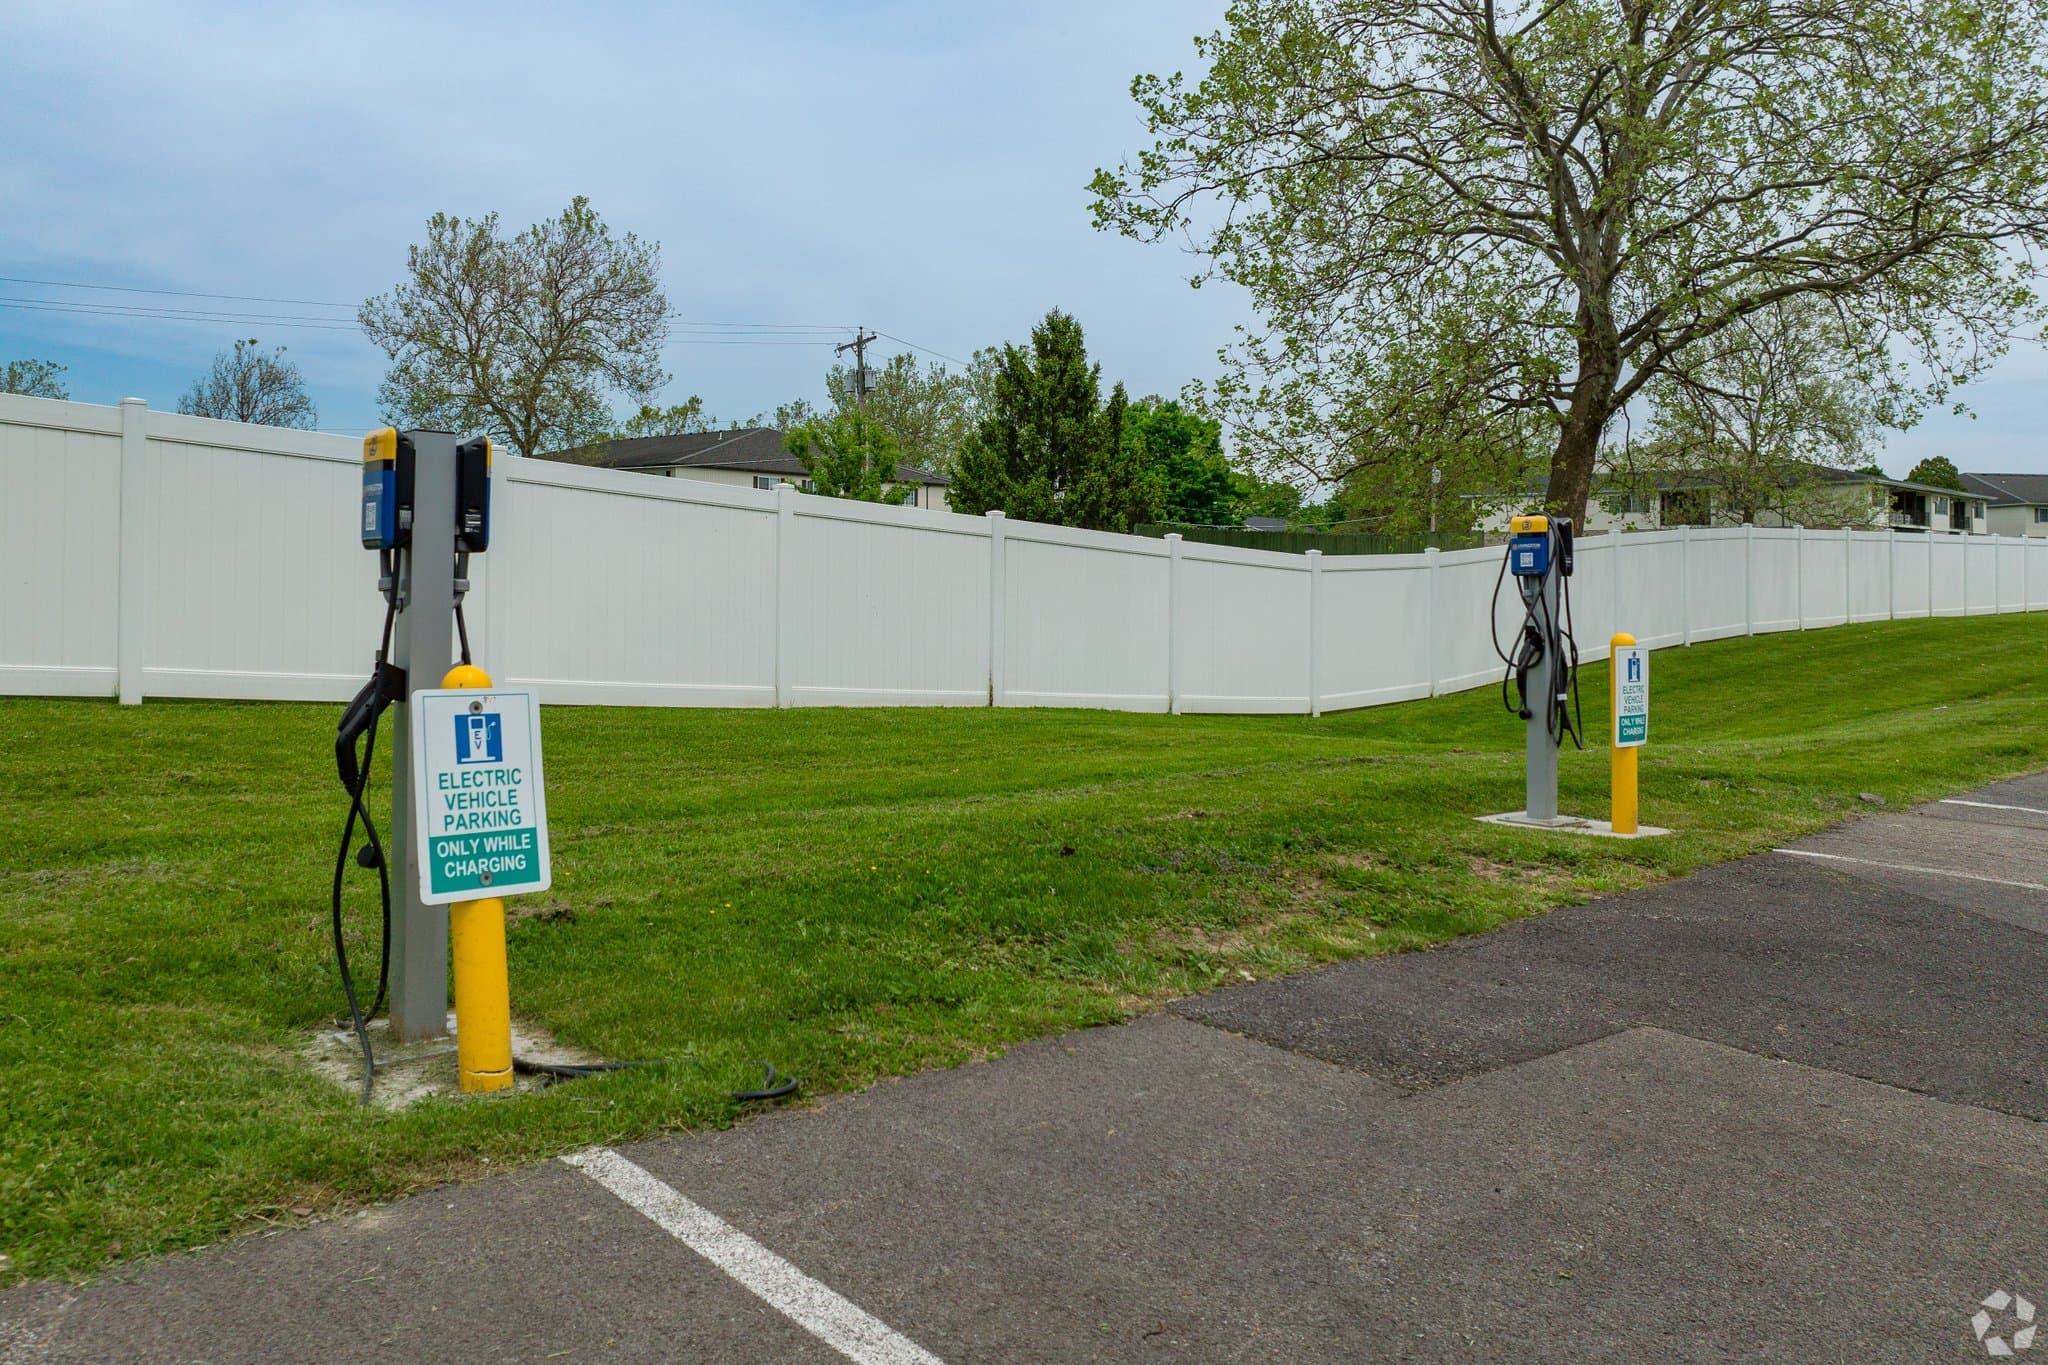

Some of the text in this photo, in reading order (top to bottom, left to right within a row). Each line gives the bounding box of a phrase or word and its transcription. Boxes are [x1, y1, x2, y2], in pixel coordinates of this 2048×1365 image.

[438, 767, 522, 790] ELECTRIC
[444, 789, 518, 810] VEHICLE
[444, 808, 521, 832] PARKING
[436, 833, 531, 858] ONLY WHILE
[444, 854, 526, 878] CHARGING
